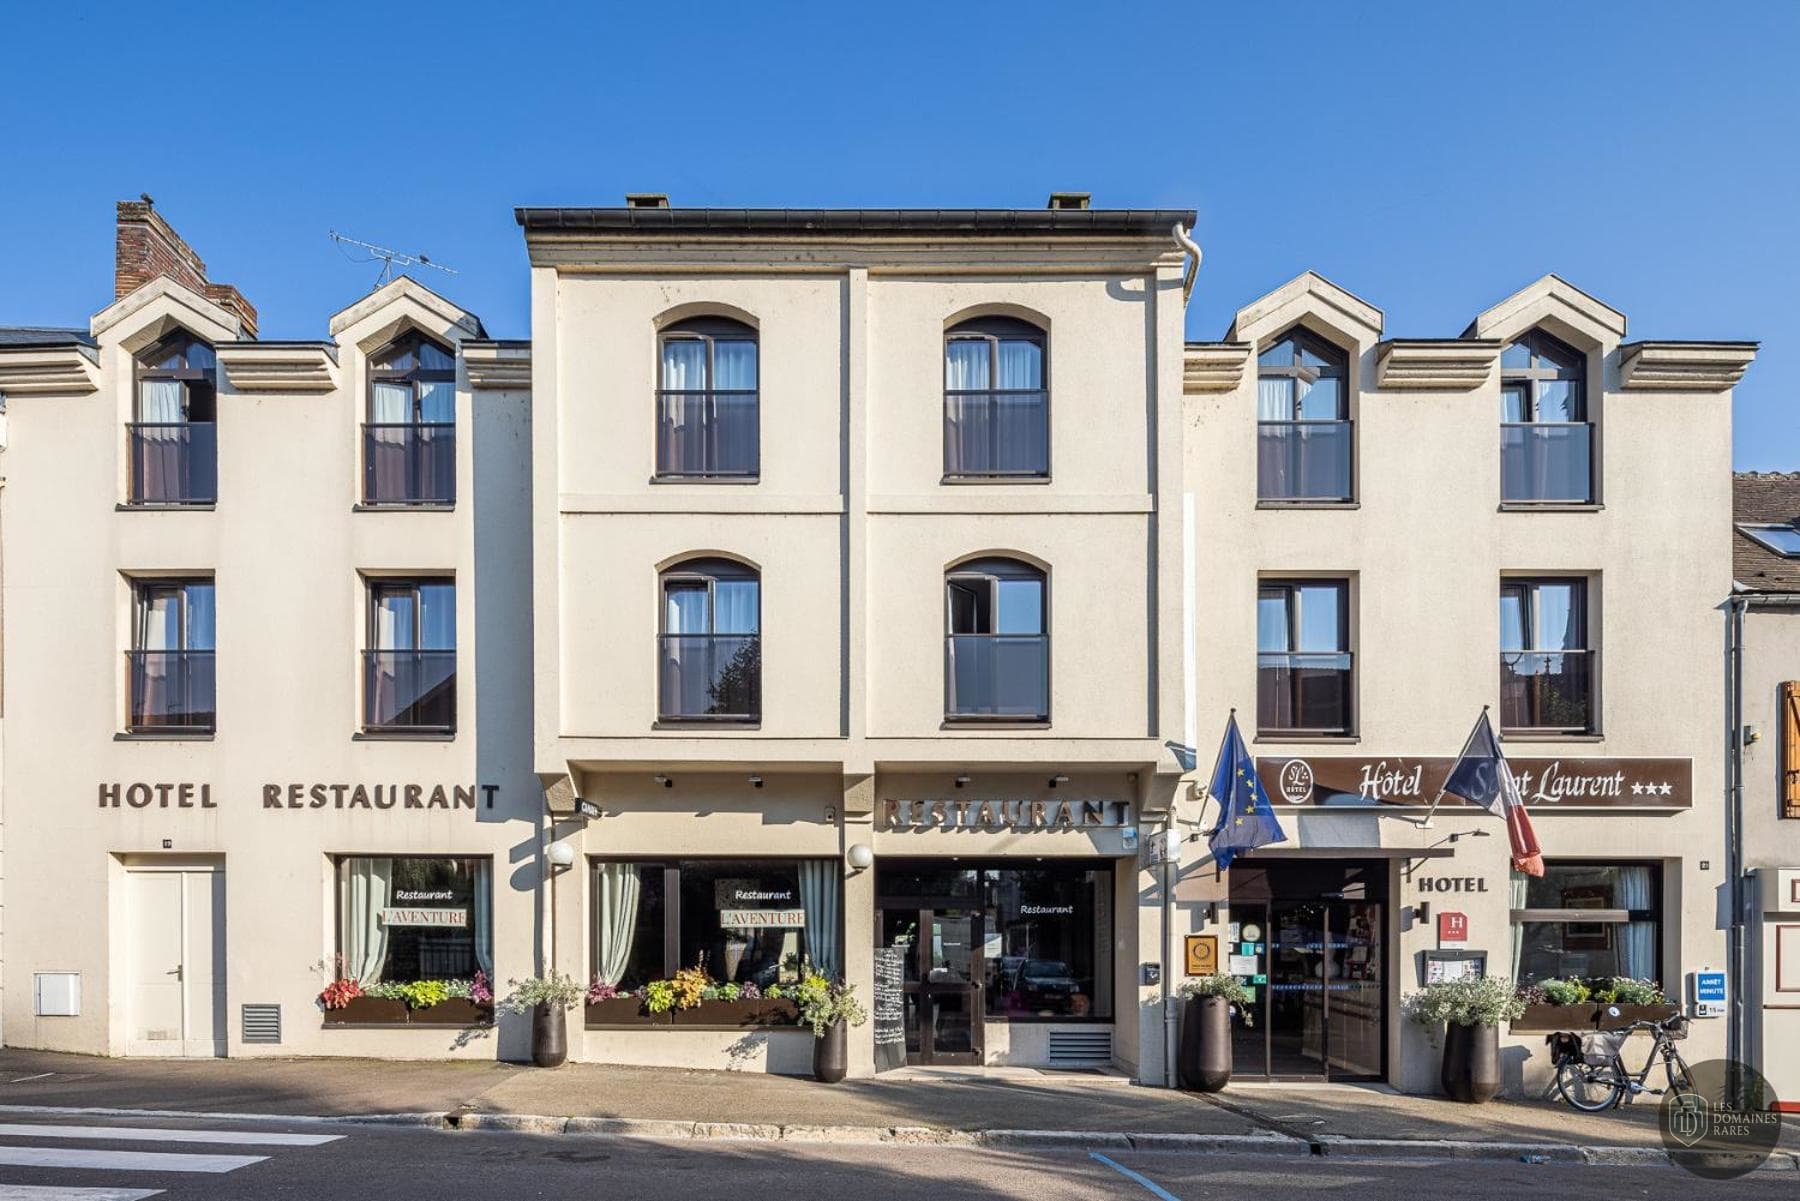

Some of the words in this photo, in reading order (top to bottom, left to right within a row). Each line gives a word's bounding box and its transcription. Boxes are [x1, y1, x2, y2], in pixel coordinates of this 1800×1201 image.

[1359, 760, 1423, 801] Hôtel
[1530, 760, 1625, 804] Laurent
[98, 782, 218, 809] HOTEL
[262, 783, 500, 810] RESTAURANT
[882, 799, 1130, 826] RESTAURANT
[1418, 876, 1488, 893] HOTEL
[396, 889, 453, 900] Restaurant
[735, 889, 792, 900] Restaurant
[1020, 905, 1075, 914] Restaurant
[722, 912, 804, 925] L'AVENTURE
[1451, 916, 1463, 928] H
